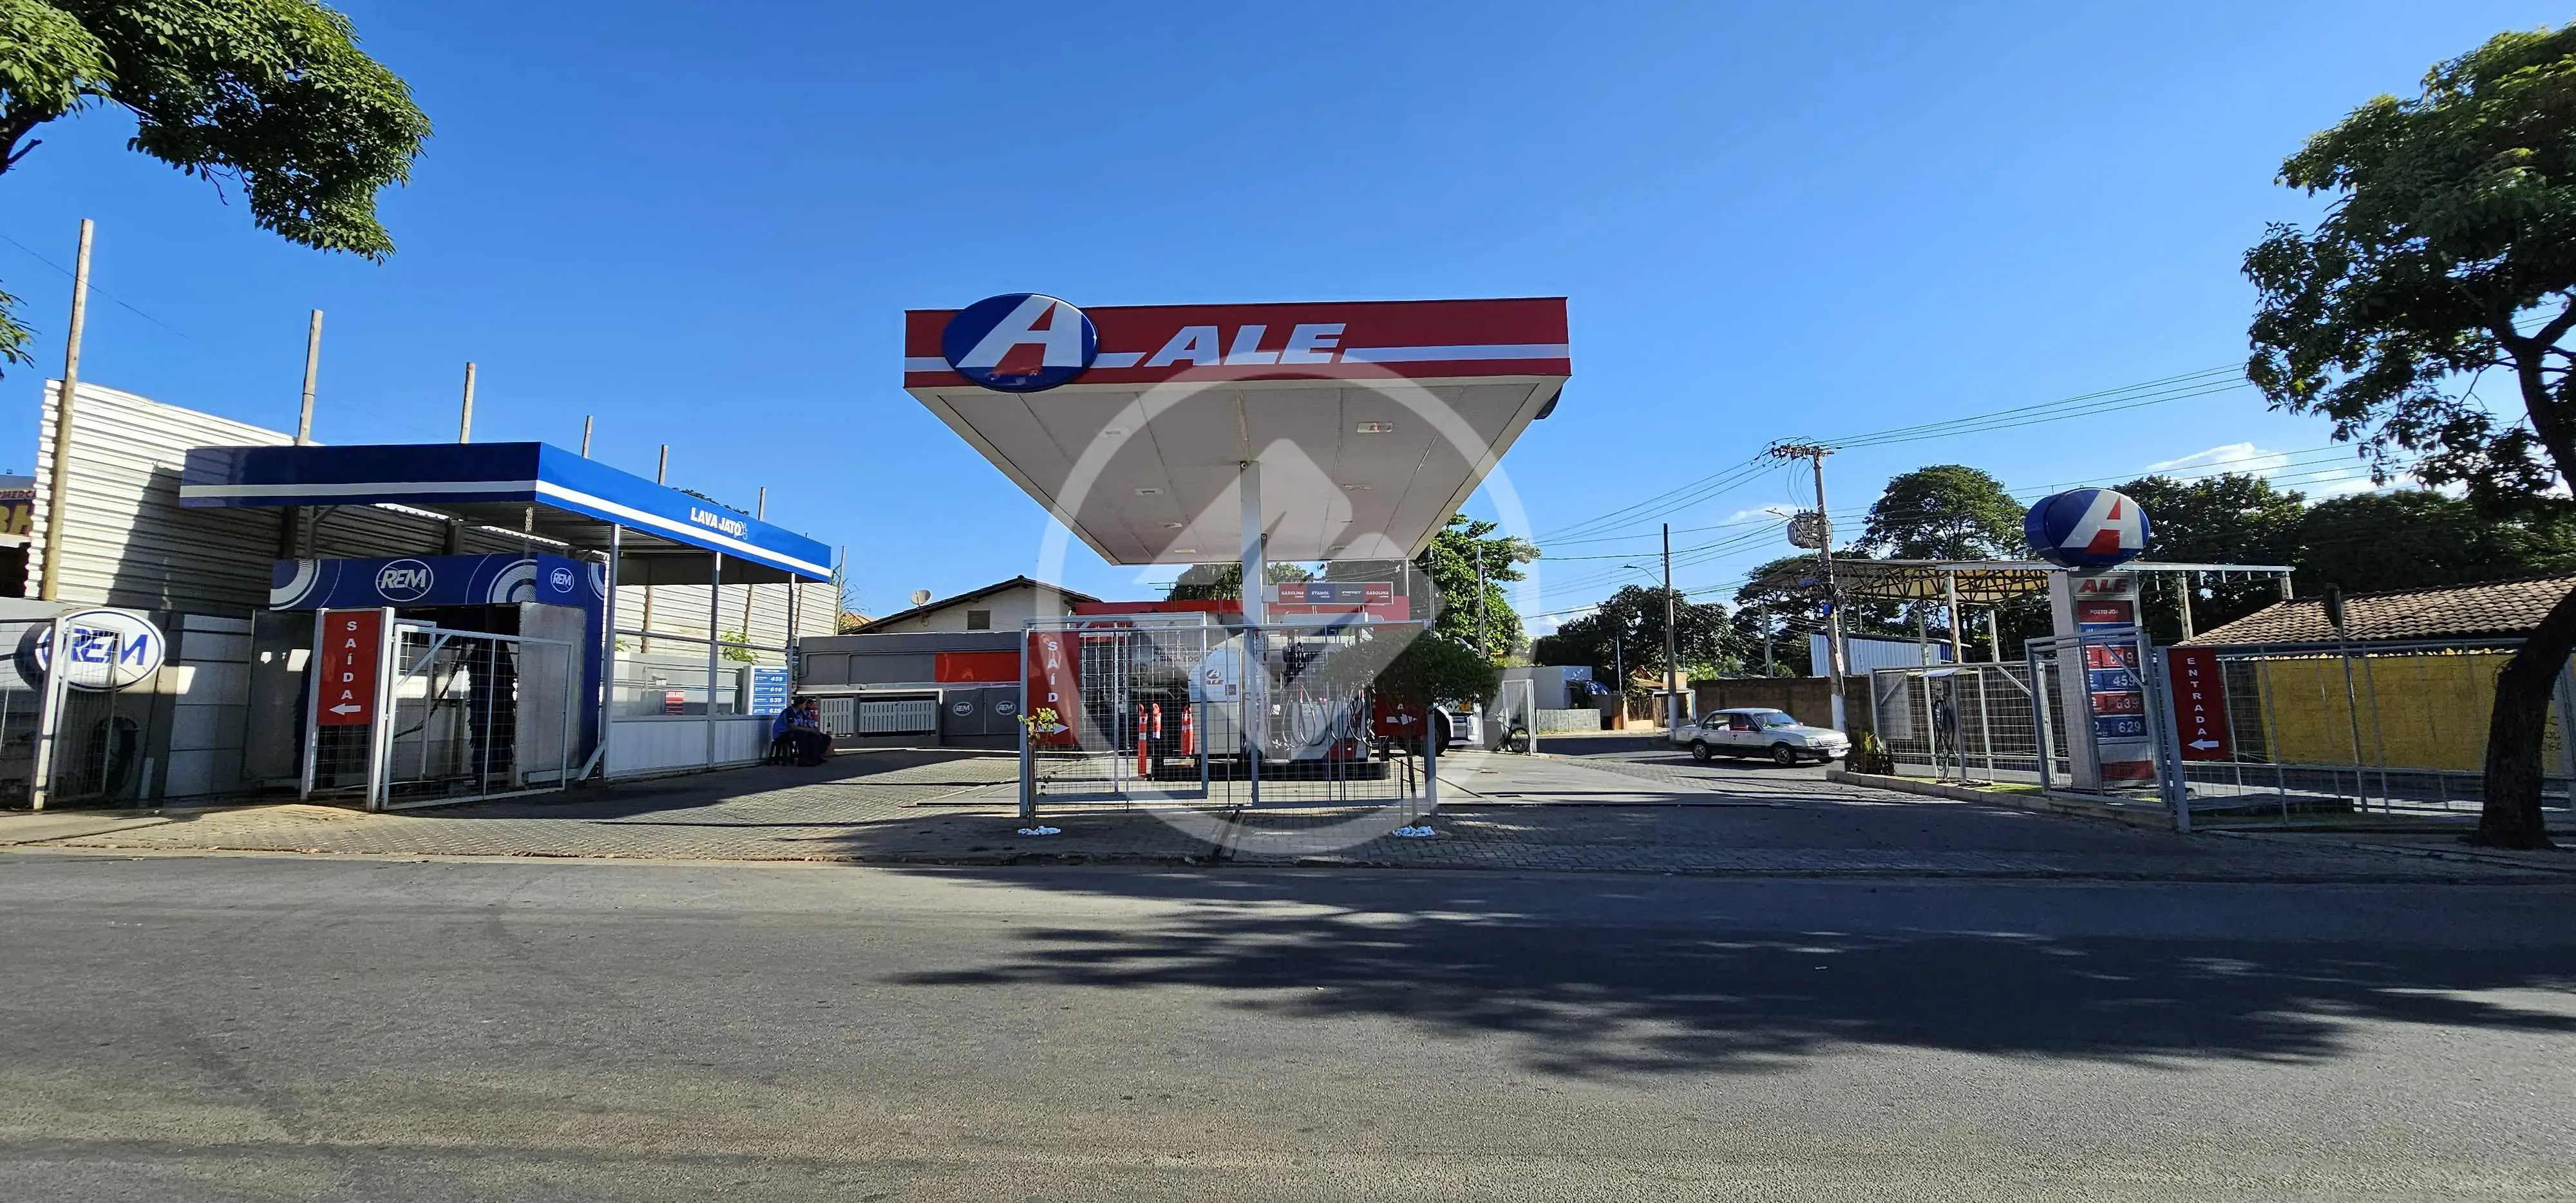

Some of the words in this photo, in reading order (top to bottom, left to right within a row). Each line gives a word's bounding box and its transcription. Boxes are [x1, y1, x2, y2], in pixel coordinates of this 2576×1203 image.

[1142, 323, 1347, 367] ALE
[690, 507, 718, 528] LAVA
[719, 517, 742, 536] JATO
[380, 569, 426, 589] REM
[553, 573, 571, 586] REM
[2078, 579, 2128, 593] ALE
[62, 628, 149, 666] REM
[341, 621, 357, 700] SAÍDA
[2113, 675, 2136, 687] 459
[2116, 697, 2138, 709] 639
[2187, 658, 2207, 735] ENTRADA
[2119, 721, 2141, 733] 629
